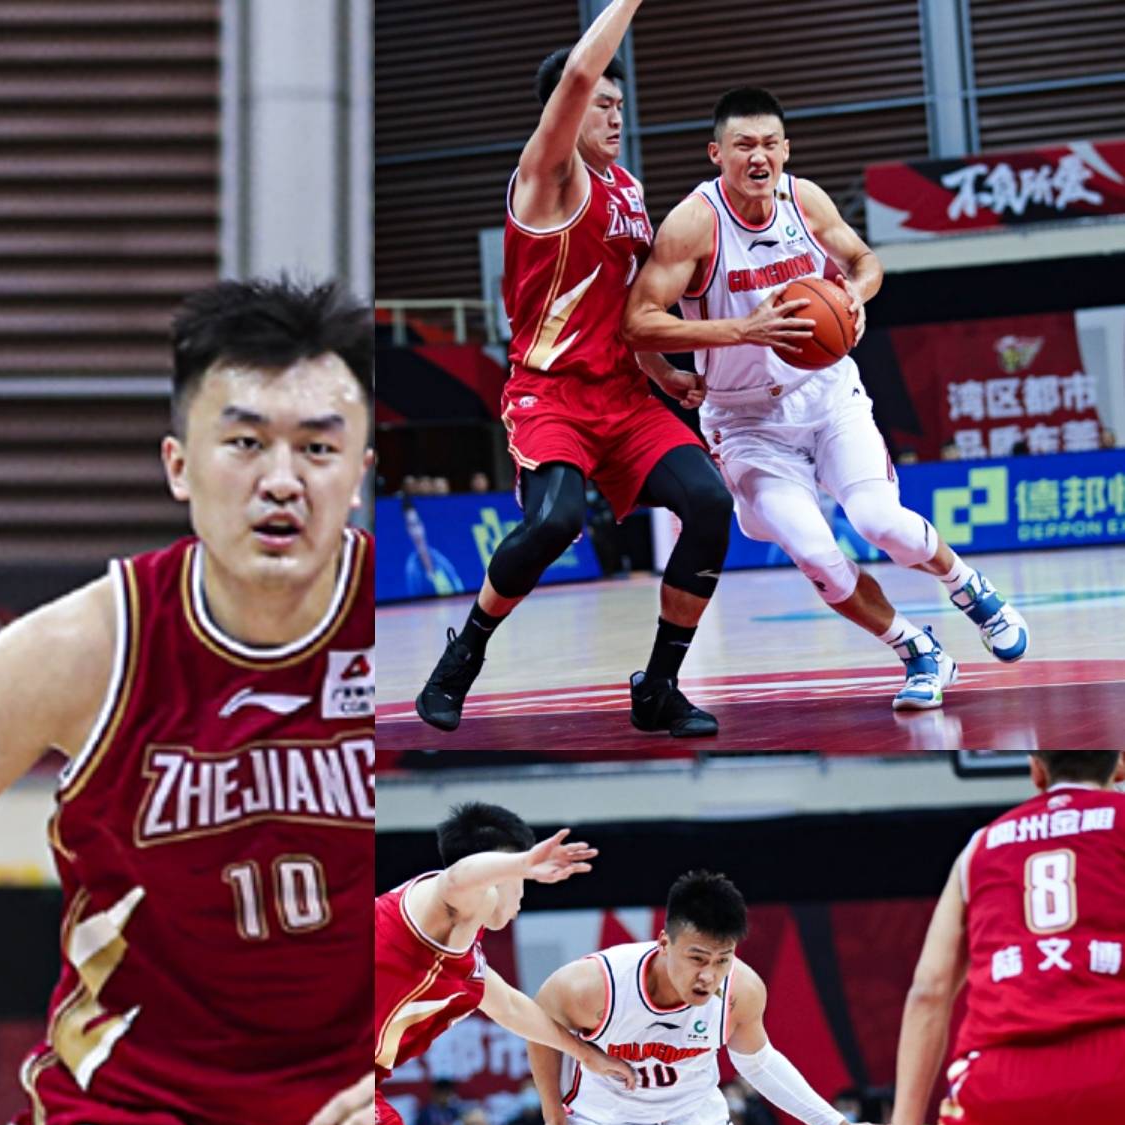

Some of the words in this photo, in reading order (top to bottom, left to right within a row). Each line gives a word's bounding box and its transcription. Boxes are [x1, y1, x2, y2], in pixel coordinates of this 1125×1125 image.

[947, 371, 1096, 421] 湾区都市
[143, 738, 375, 837] ZHEJIANG
[222, 854, 331, 941] 10
[1024, 848, 1077, 935] 8
